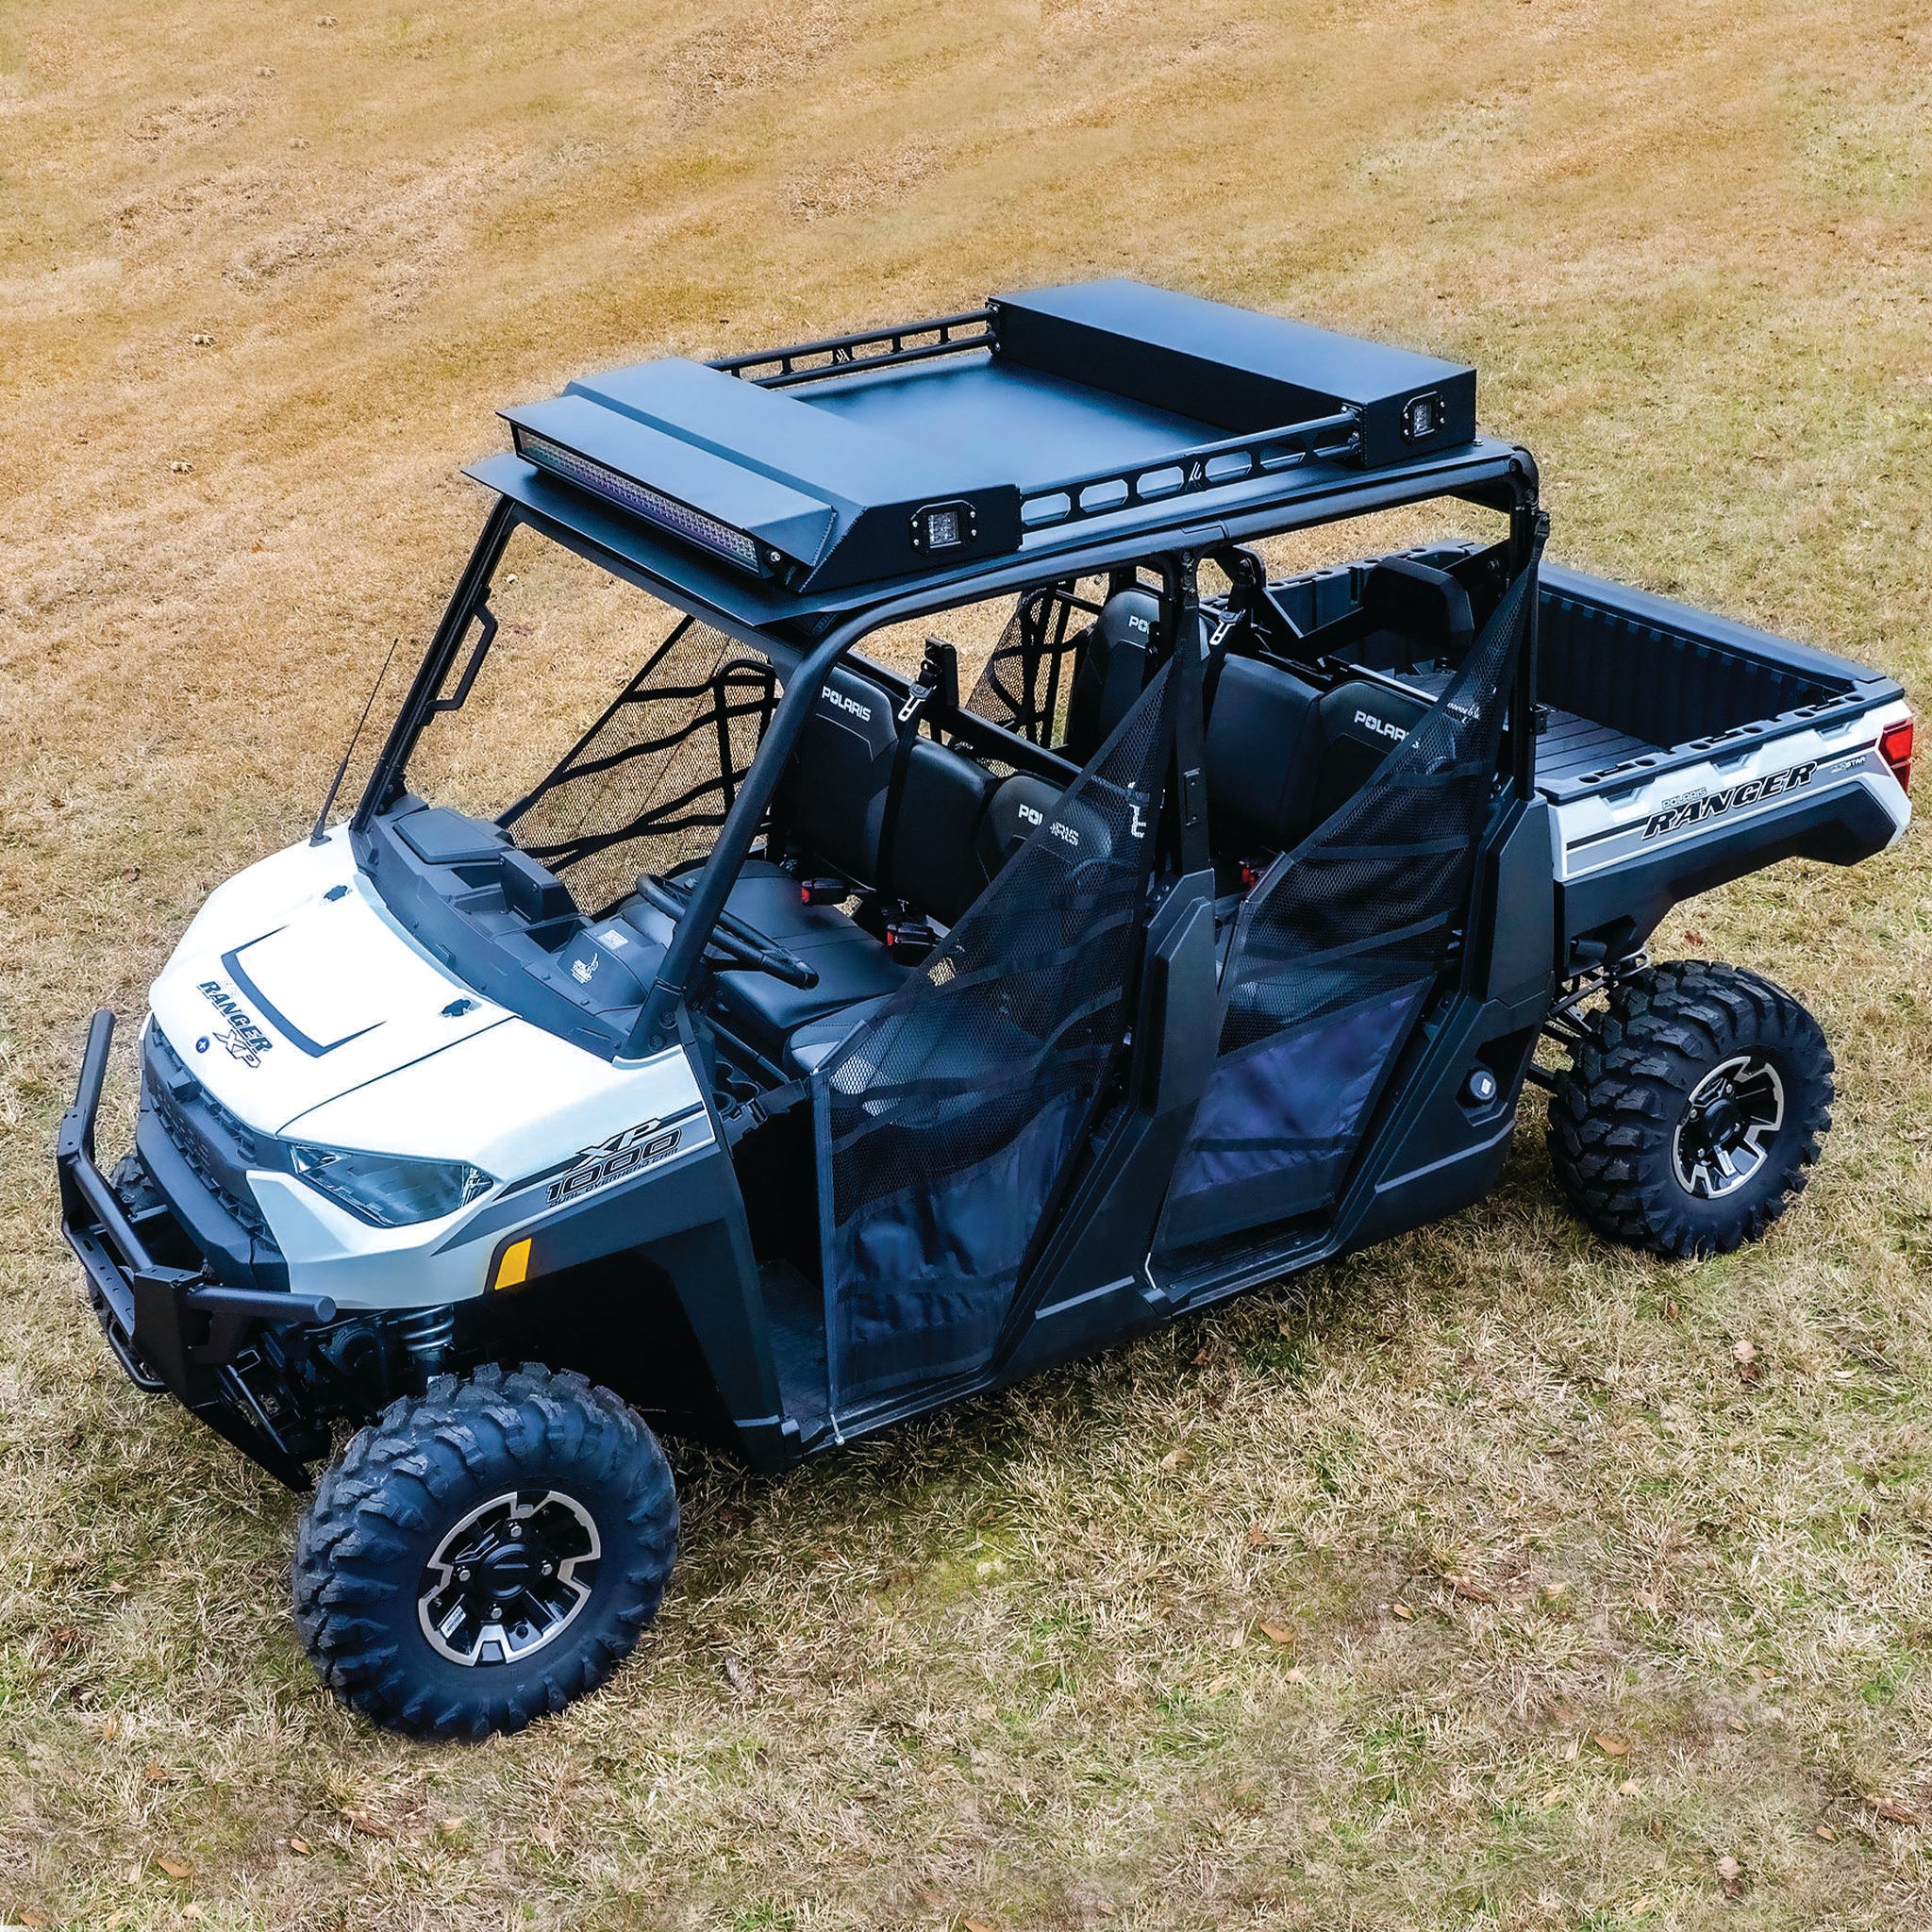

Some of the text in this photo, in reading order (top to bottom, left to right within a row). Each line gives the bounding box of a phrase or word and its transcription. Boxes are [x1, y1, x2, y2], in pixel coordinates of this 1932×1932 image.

[822, 685, 872, 722] POLARIS
[1354, 709, 1422, 750] POLAR
[1641, 760, 1818, 840] RANGER
[1661, 787, 1708, 809] POLARIS
[1018, 804, 1080, 846] PORIS
[196, 980, 274, 1054] RANGER
[212, 1029, 261, 1069] XP
[546, 1128, 682, 1204] 1000
[563, 1117, 662, 1176] XP
